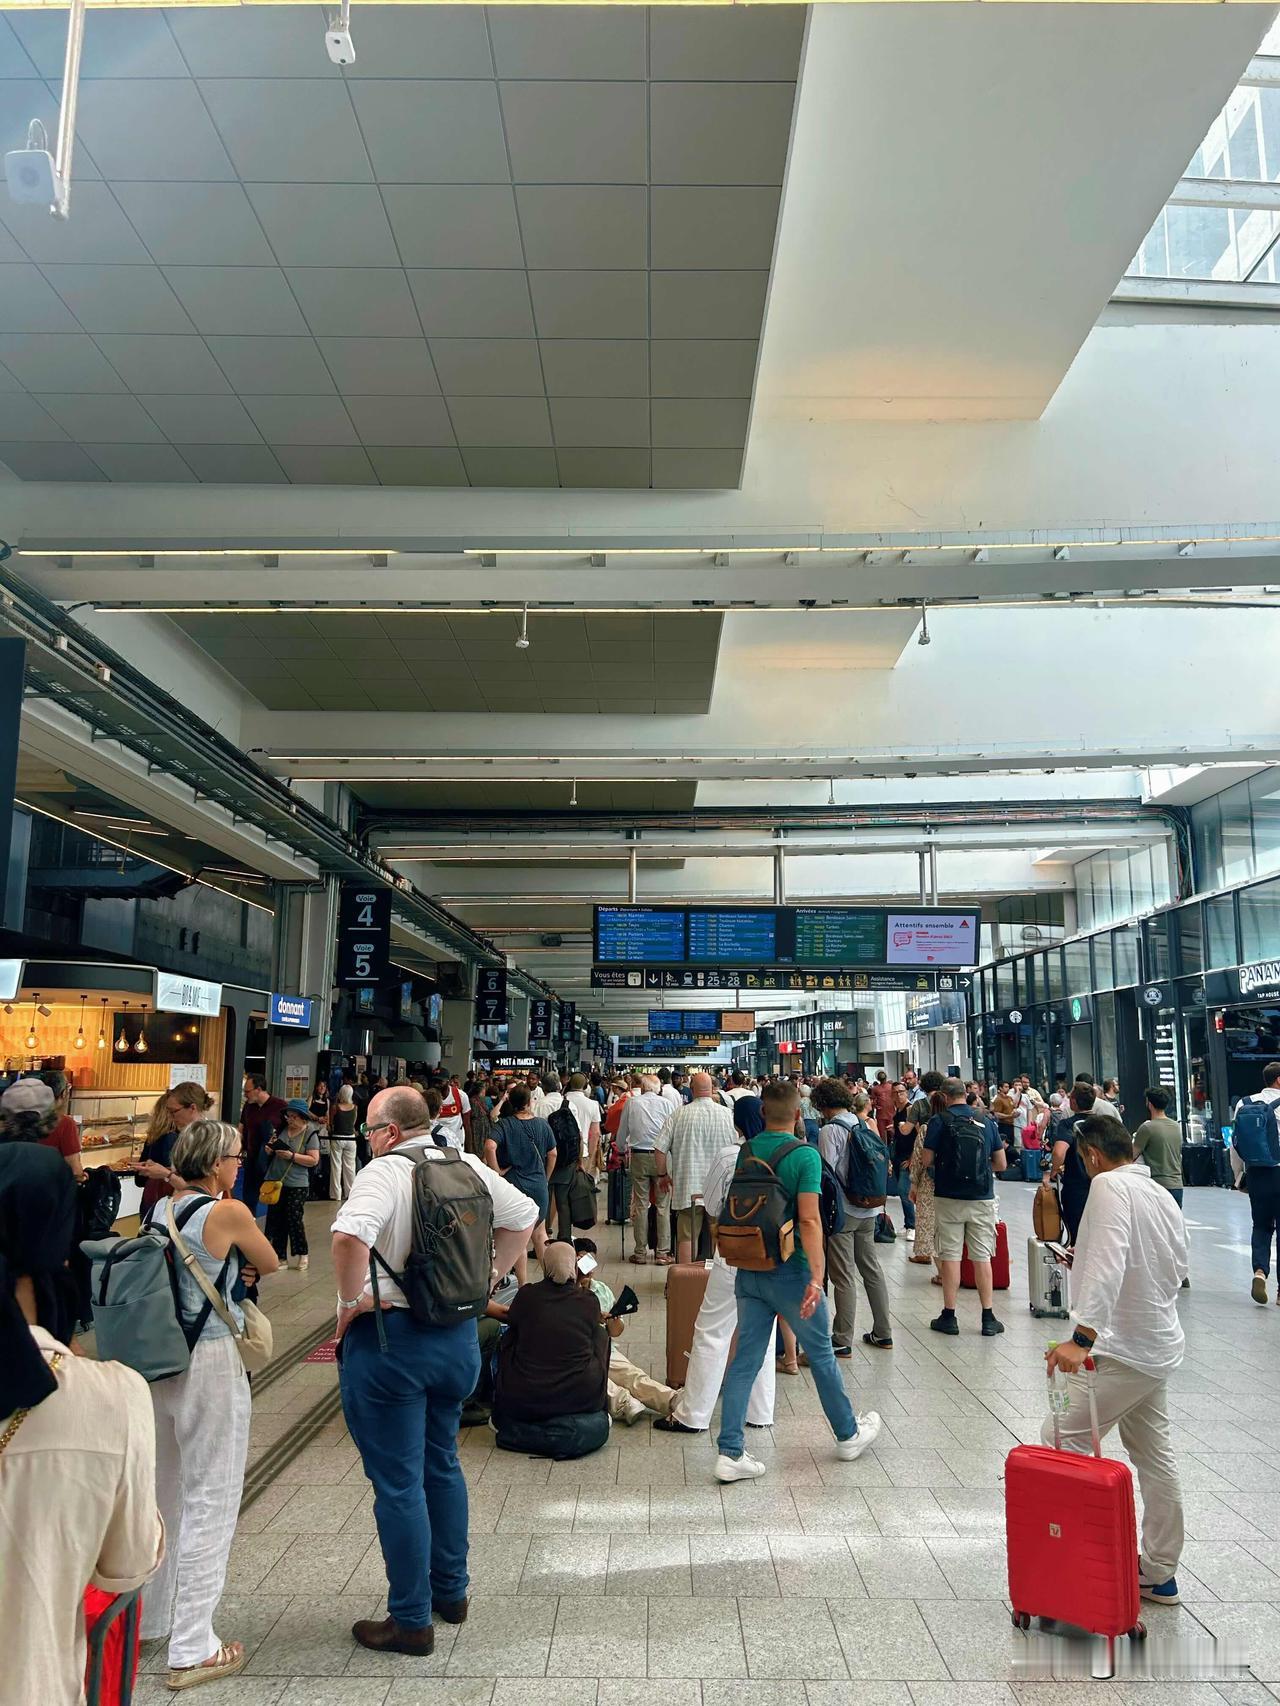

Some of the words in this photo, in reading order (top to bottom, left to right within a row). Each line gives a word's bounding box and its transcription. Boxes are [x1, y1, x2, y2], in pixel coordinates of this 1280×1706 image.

[357, 905, 373, 926] 4
[355, 954, 371, 977] 5
[488, 977, 496, 990] 6
[707, 976, 720, 985] 25
[728, 976, 740, 985] 28
[277, 996, 304, 1016] donnant
[487, 1005, 497, 1018] 7
[537, 1006, 544, 1016] 8
[537, 1026, 544, 1035] 9
